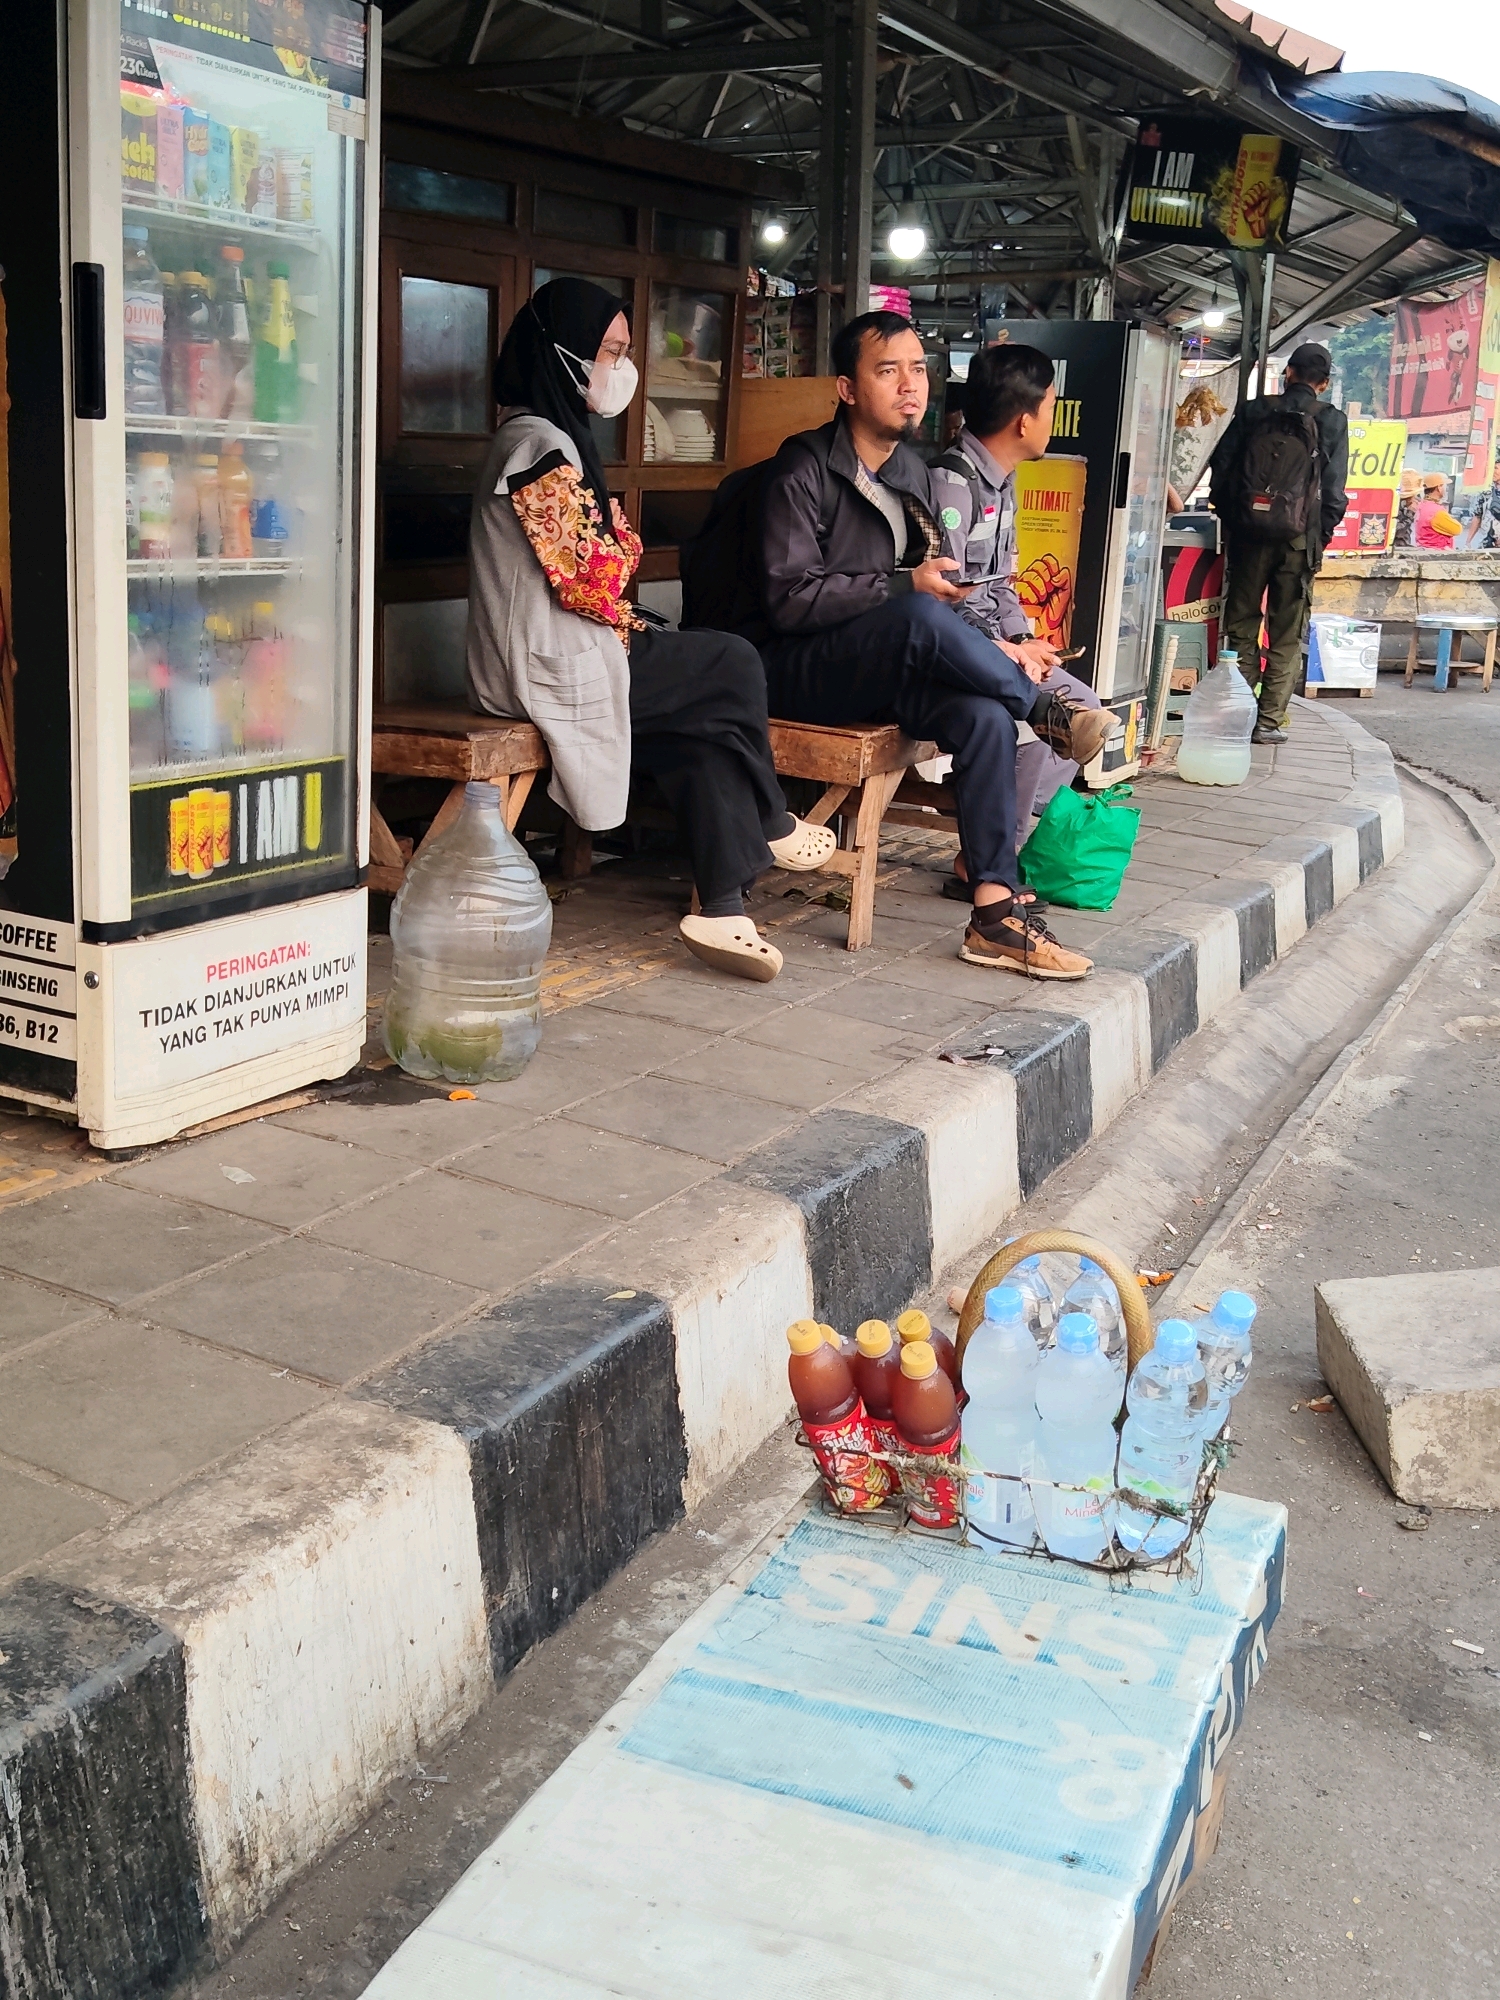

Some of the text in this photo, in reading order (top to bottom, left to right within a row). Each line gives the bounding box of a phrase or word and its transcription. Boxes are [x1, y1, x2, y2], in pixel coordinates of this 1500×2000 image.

[121, 132, 156, 166] teh
[1151, 150, 1195, 189] I AM
[1130, 186, 1207, 229] ULTIMATE
[1022, 489, 1073, 513] ULTIMATE
[256, 774, 299, 861] AM
[0, 922, 58, 953] OFFEE
[206, 940, 312, 983] PERINGATAN:
[0, 969, 59, 998] INSENG
[139, 951, 357, 1028] TIDAK DIANJURKAN UNTUK
[25, 1018, 59, 1044] B12
[159, 981, 350, 1054] YANG TAK PUNYA MIMPI
